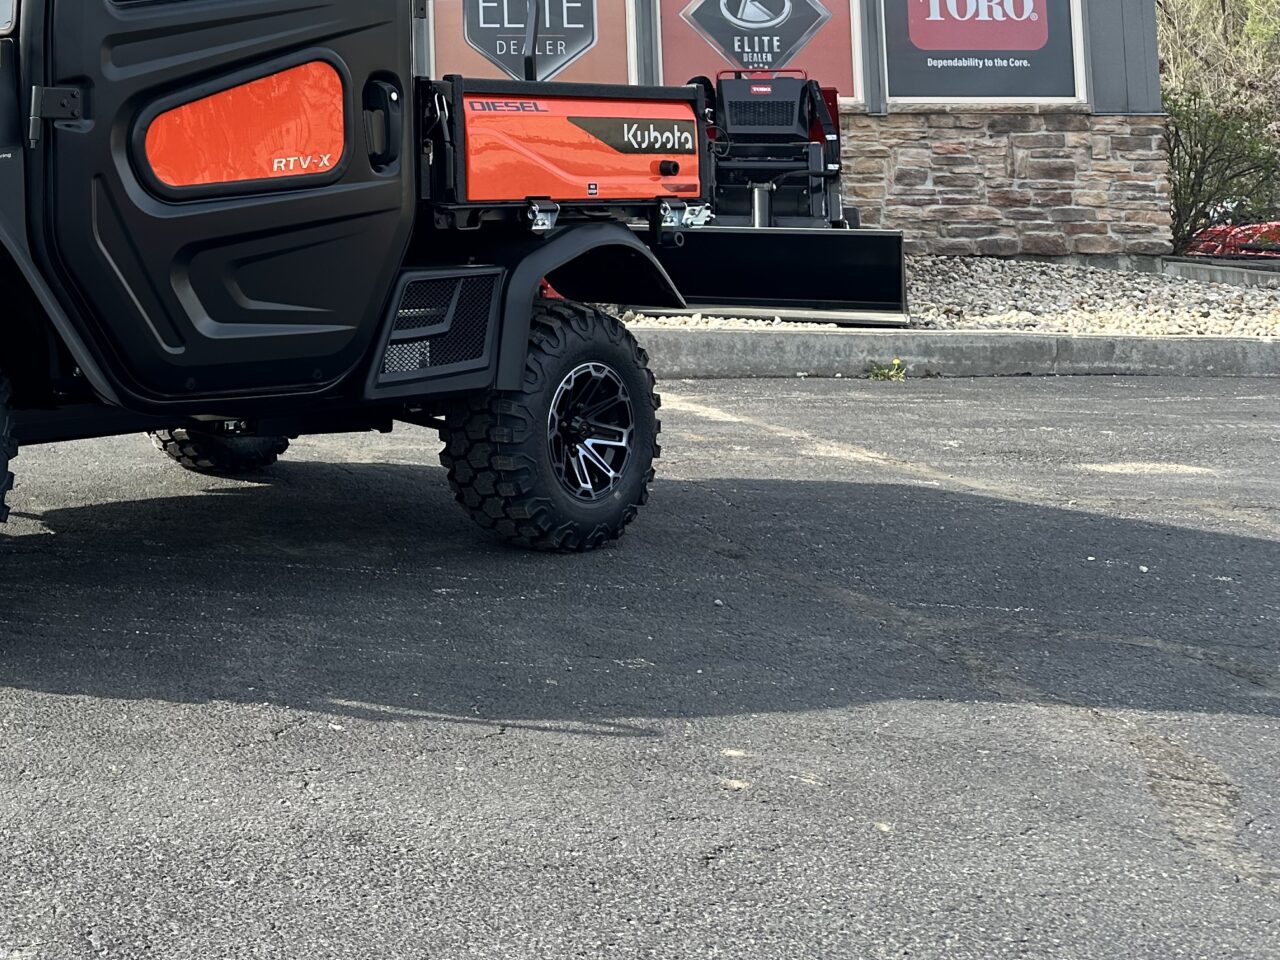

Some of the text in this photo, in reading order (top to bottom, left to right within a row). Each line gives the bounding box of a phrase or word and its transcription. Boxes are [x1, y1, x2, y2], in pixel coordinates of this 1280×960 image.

[496, 40, 566, 55] DELER
[733, 36, 781, 52] ELITE
[743, 53, 773, 63] DEALER
[927, 57, 1031, 69] Dependability to the Core.
[469, 100, 549, 113] DIESEL
[623, 122, 693, 150] Kubota
[272, 153, 332, 172] RTV-X
